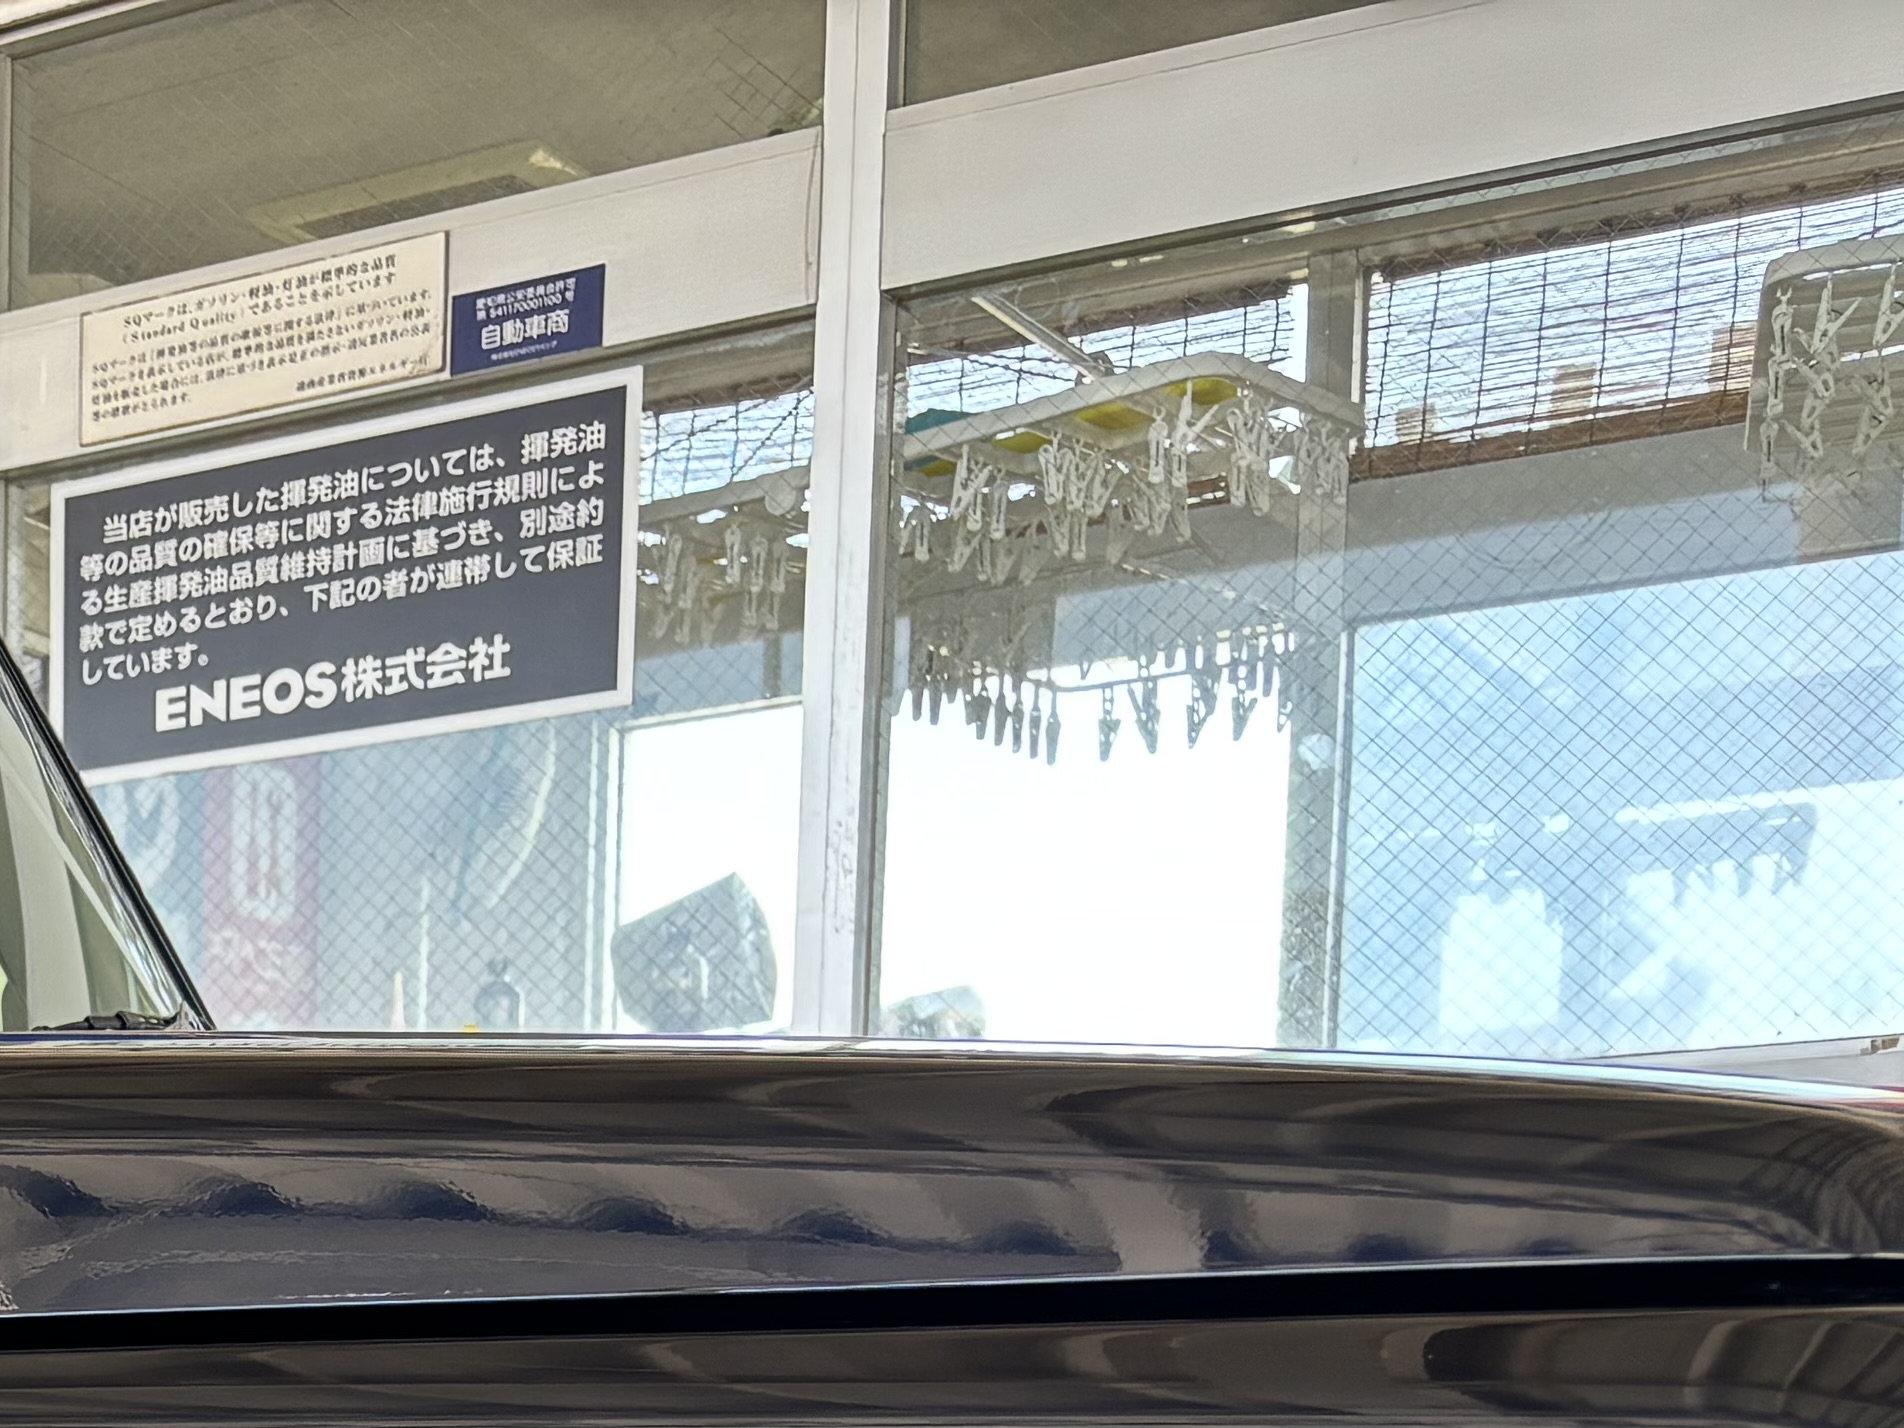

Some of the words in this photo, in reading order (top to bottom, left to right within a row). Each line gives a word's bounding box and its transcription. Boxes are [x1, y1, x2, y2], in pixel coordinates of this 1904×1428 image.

[480, 308, 570, 350] 自動車商
[82, 642, 210, 686] しています。
[155, 633, 512, 732] ENEOS株式会社
